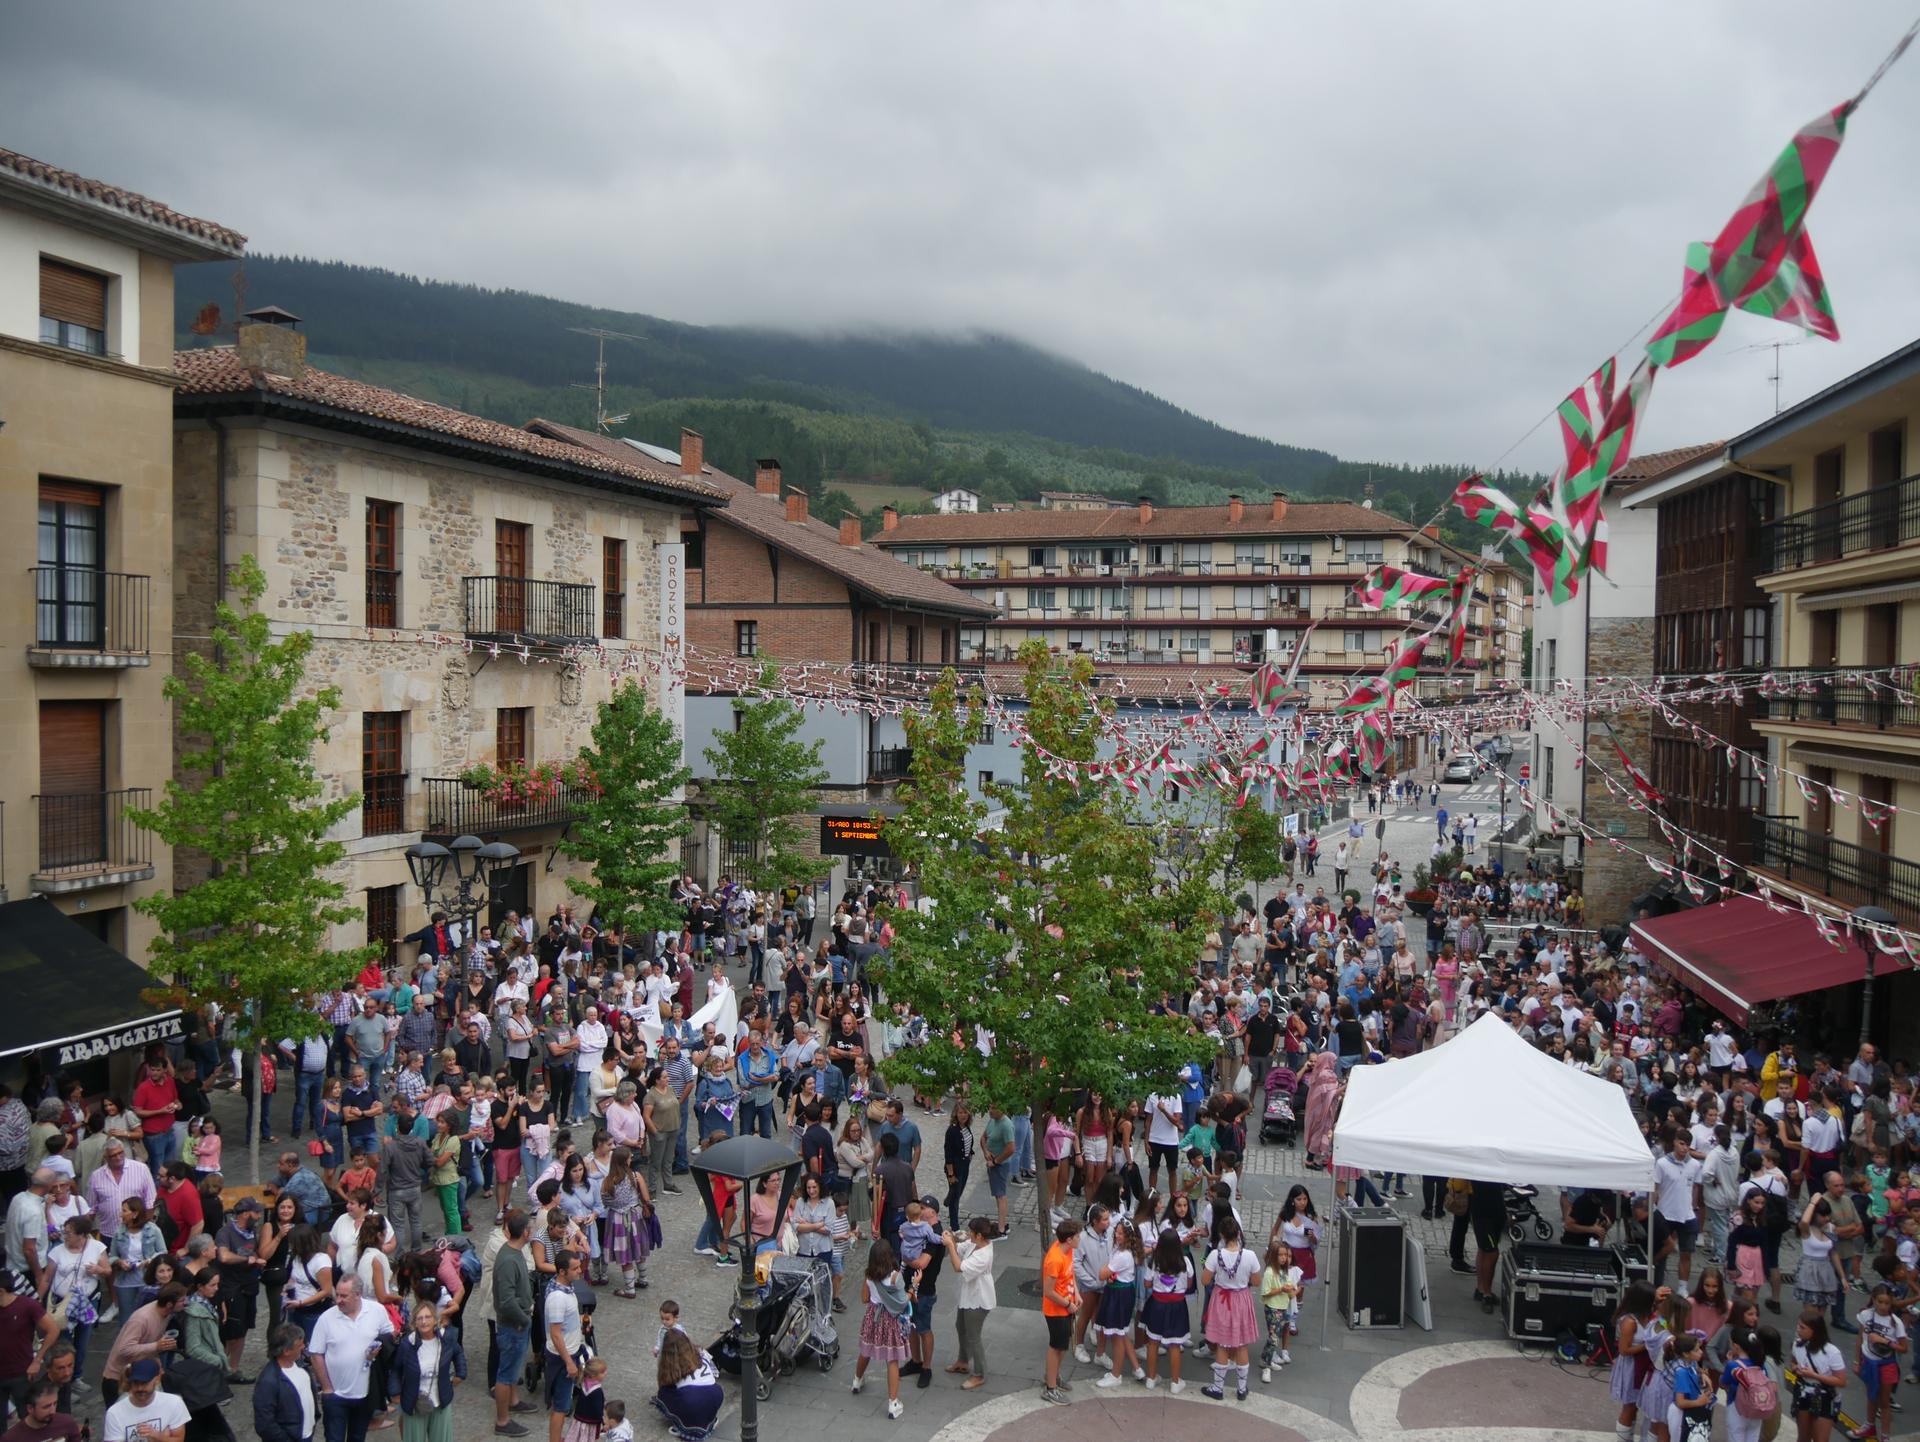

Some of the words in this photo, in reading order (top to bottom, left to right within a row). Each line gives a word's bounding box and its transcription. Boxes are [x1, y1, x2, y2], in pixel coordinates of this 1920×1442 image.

[667, 554, 677, 626] OROZKO
[842, 832, 878, 840] SEPTIEMBRE
[59, 1017, 183, 1066] ARRUGAETA
